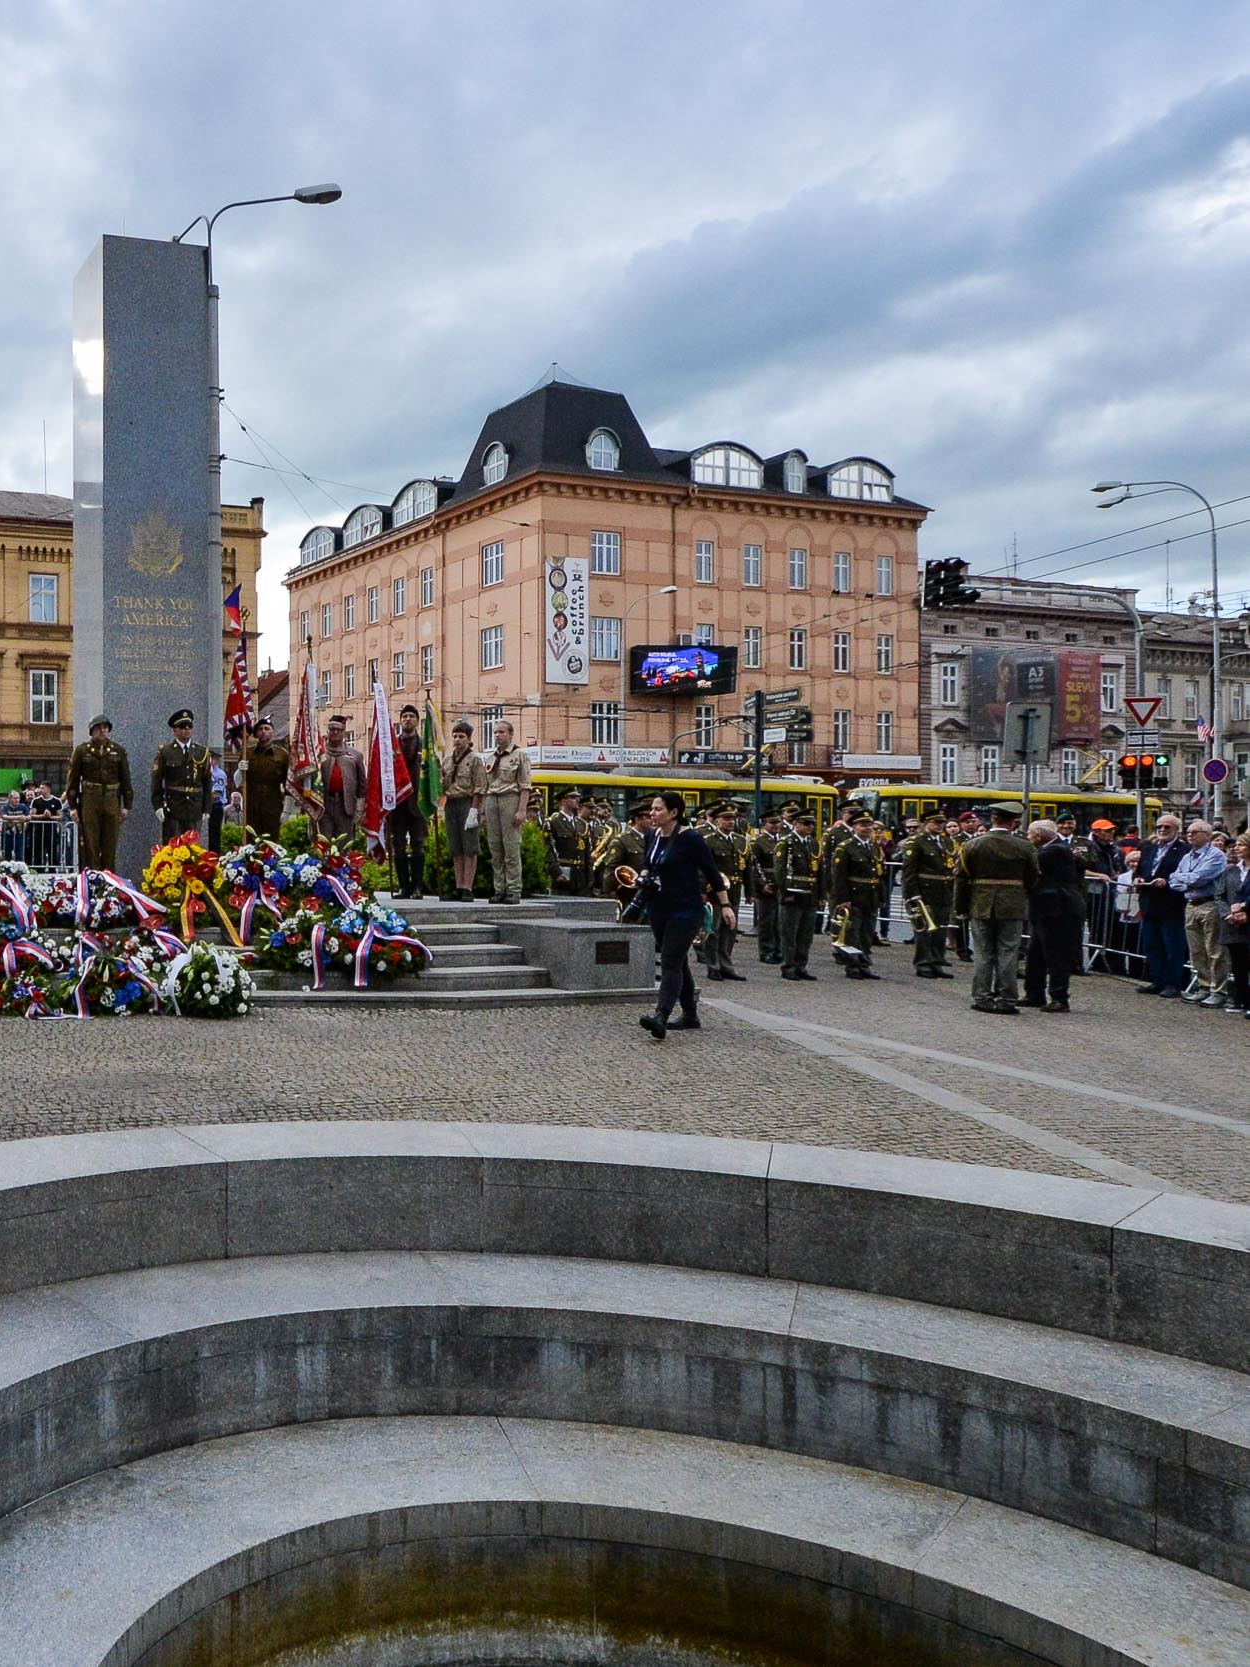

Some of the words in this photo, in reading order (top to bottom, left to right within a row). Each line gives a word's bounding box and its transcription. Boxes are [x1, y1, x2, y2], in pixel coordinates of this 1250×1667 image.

[113, 595, 165, 610] THANK
[570, 588, 578, 635] coffee
[577, 585, 585, 636] brunch
